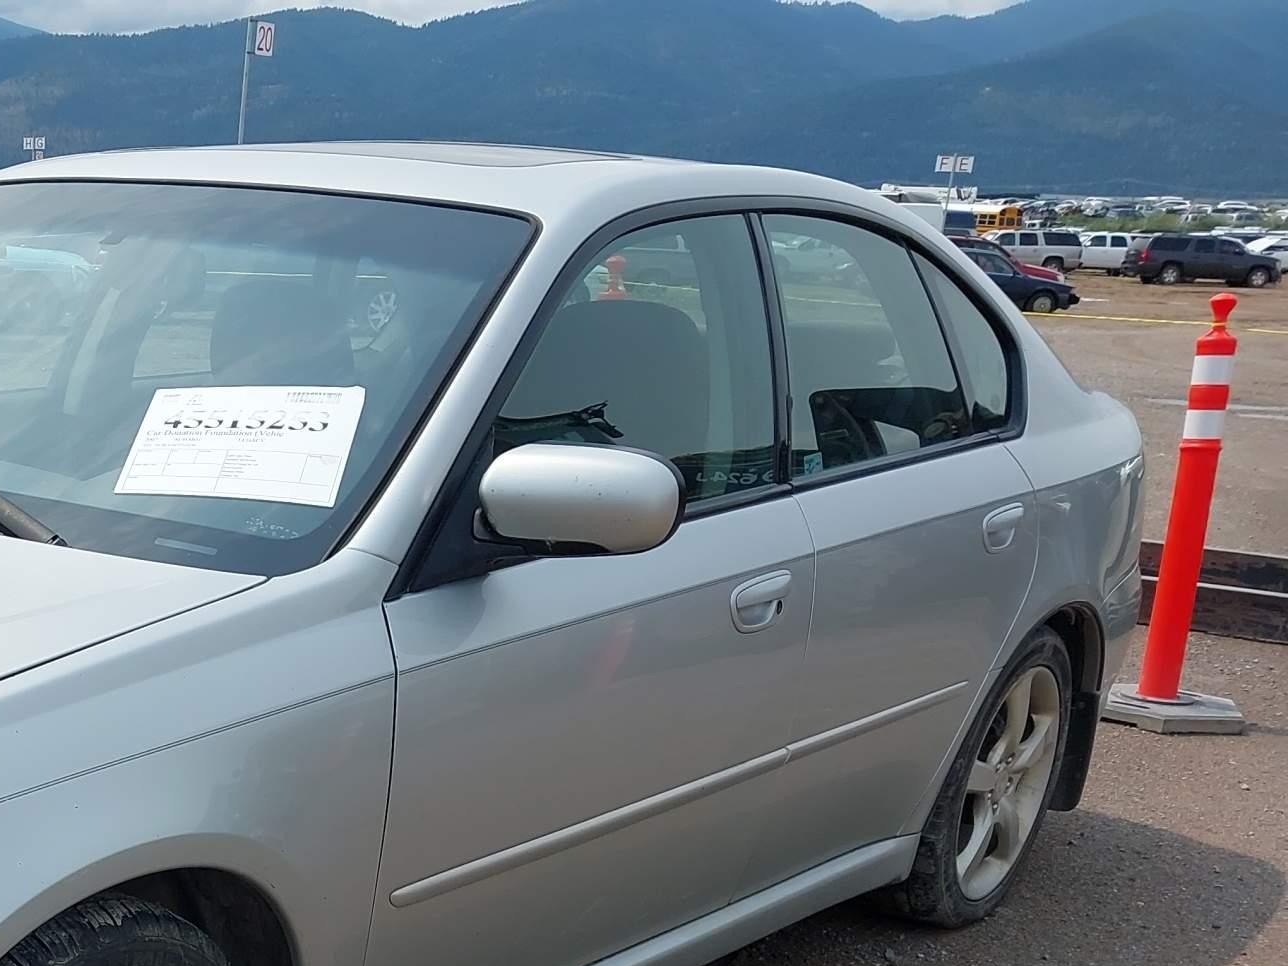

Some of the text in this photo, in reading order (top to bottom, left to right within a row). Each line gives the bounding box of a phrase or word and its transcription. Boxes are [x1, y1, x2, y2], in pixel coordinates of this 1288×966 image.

[257, 25, 273, 52] 20
[939, 157, 969, 171] F E
[163, 410, 330, 432] 45515253
